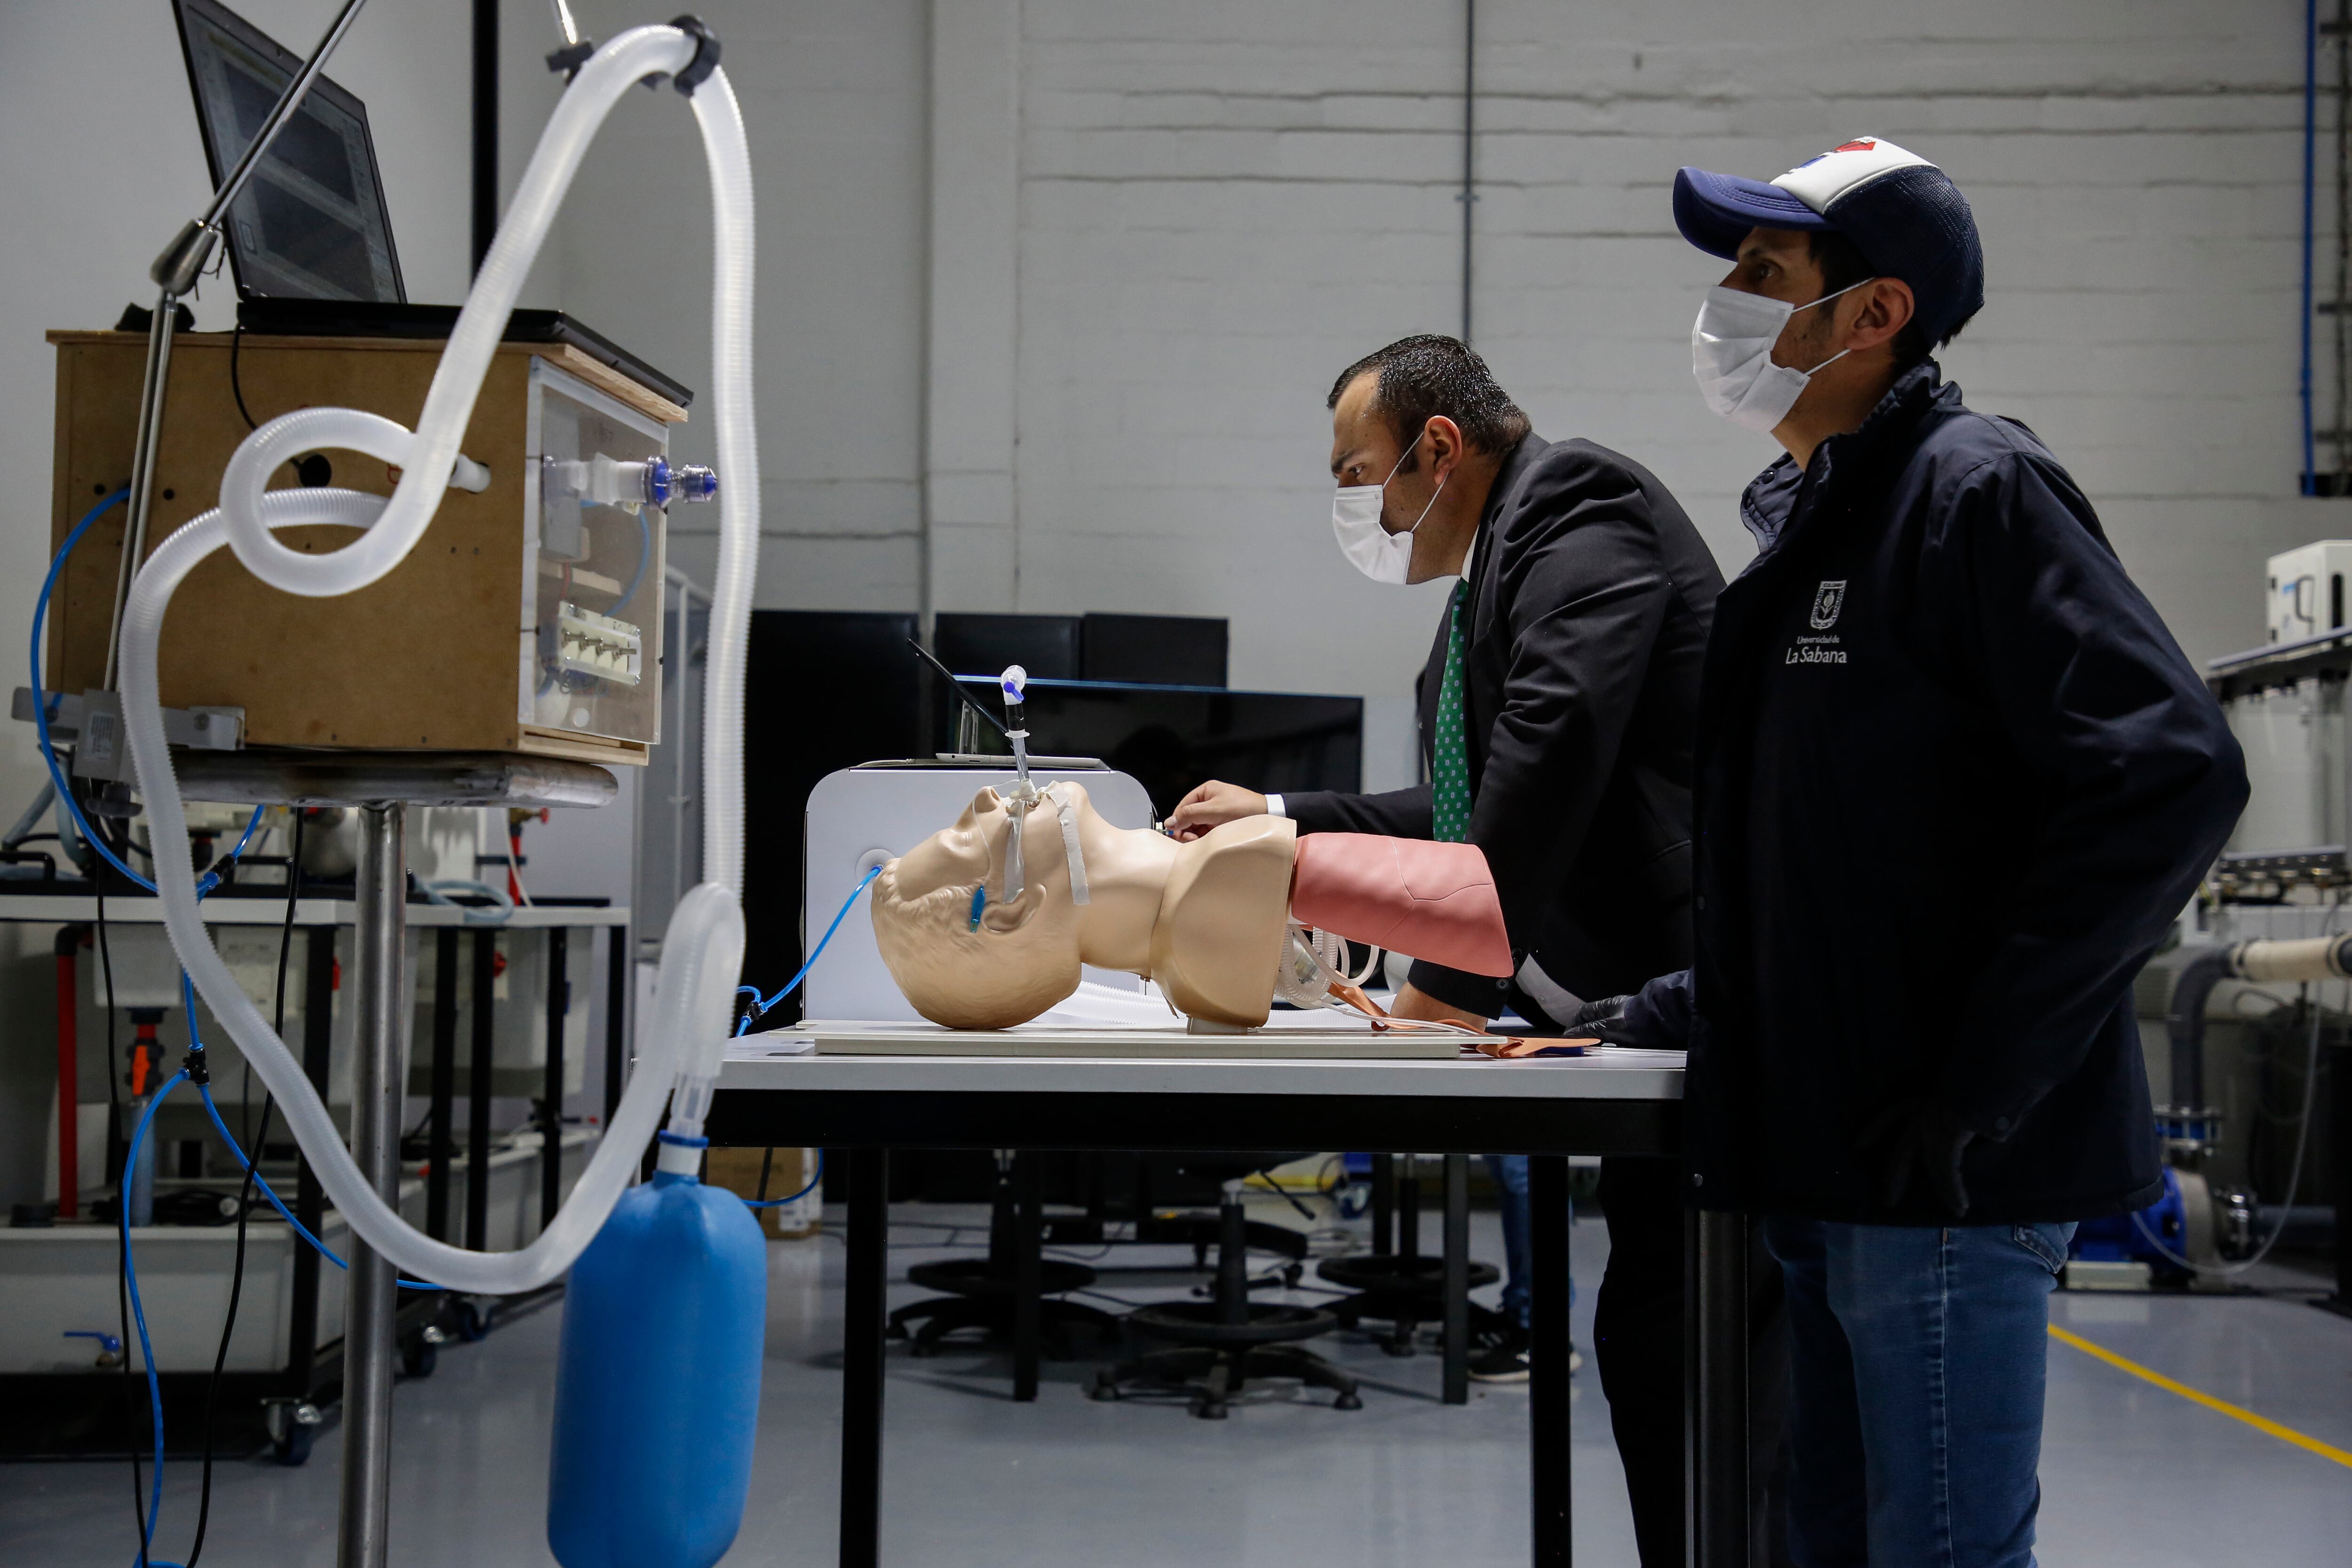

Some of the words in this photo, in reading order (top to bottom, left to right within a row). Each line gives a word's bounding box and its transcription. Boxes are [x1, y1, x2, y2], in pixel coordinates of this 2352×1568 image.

[1797, 635, 1833, 644] Universidad
[1786, 647, 1799, 664] La
[1800, 646, 1847, 663] Sabana
